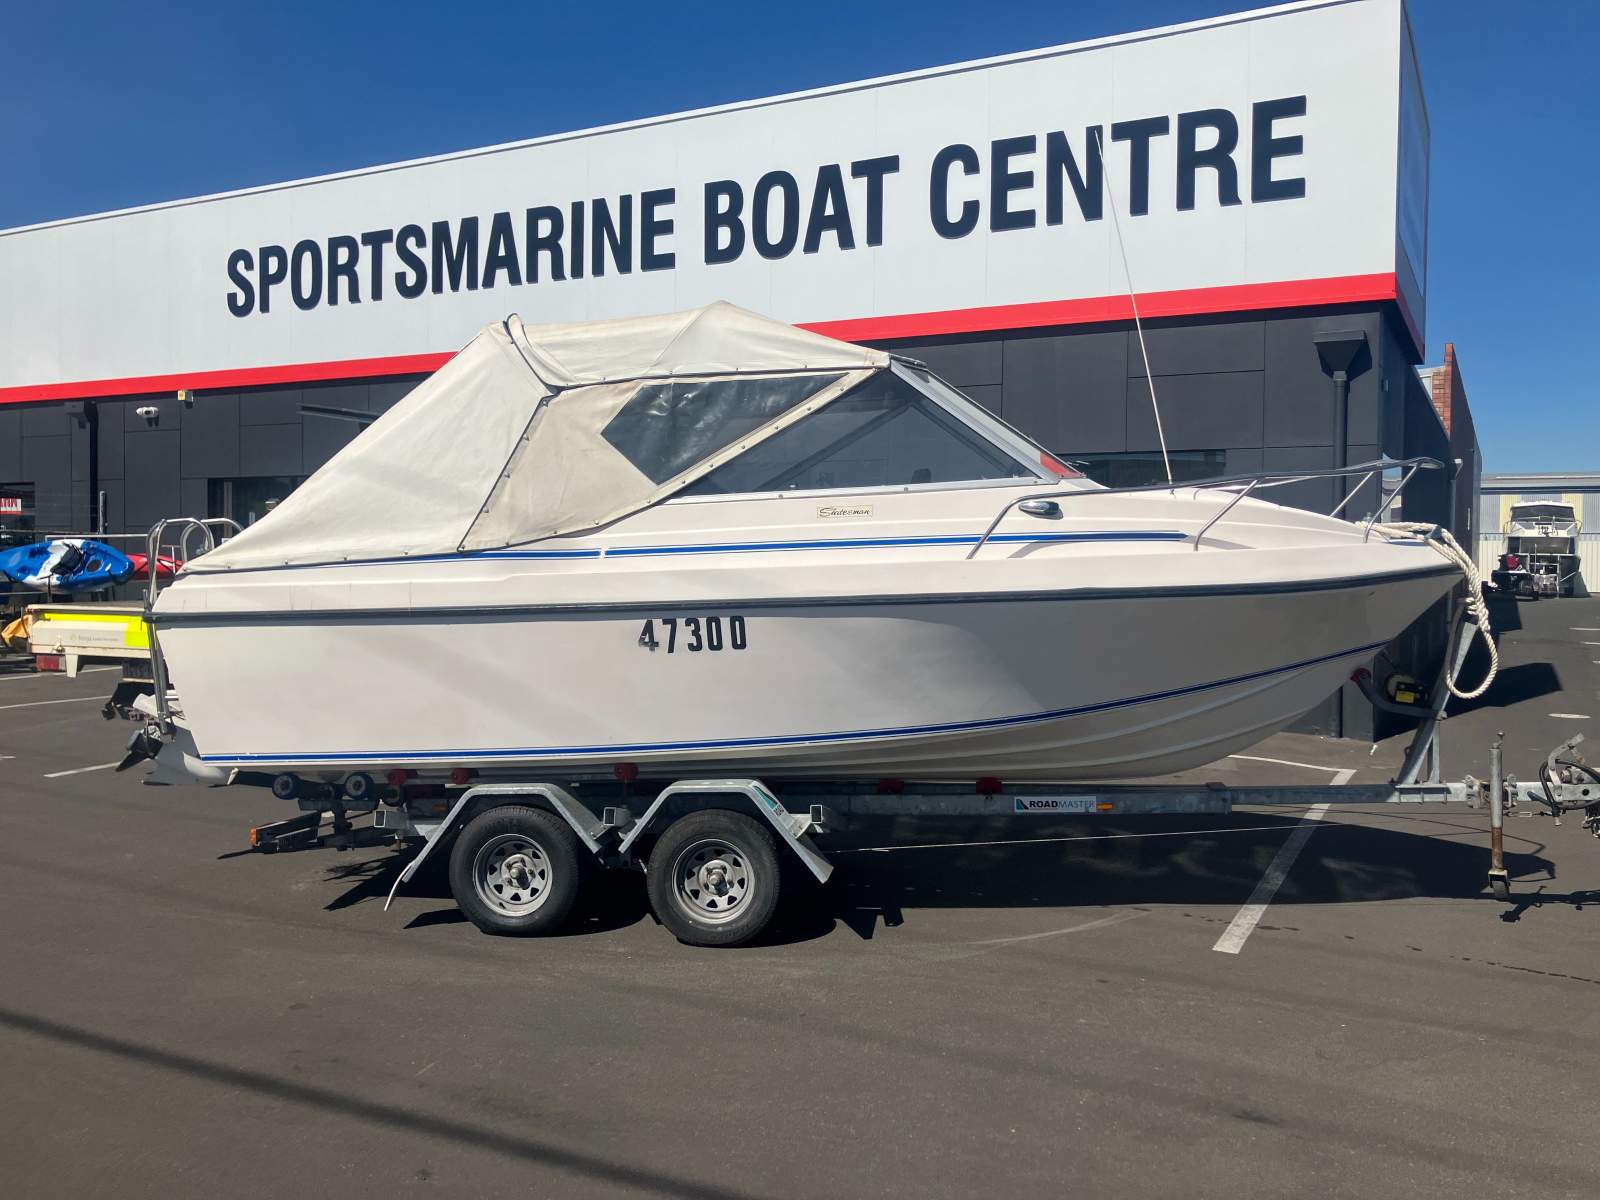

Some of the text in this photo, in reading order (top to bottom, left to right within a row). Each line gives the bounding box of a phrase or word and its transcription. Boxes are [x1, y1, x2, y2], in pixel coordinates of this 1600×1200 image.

[227, 95, 1307, 317] SPORTSMARINE BOAT CENTRE
[638, 616, 747, 653] 47300
[1029, 800, 1095, 809] ROADMASTER
